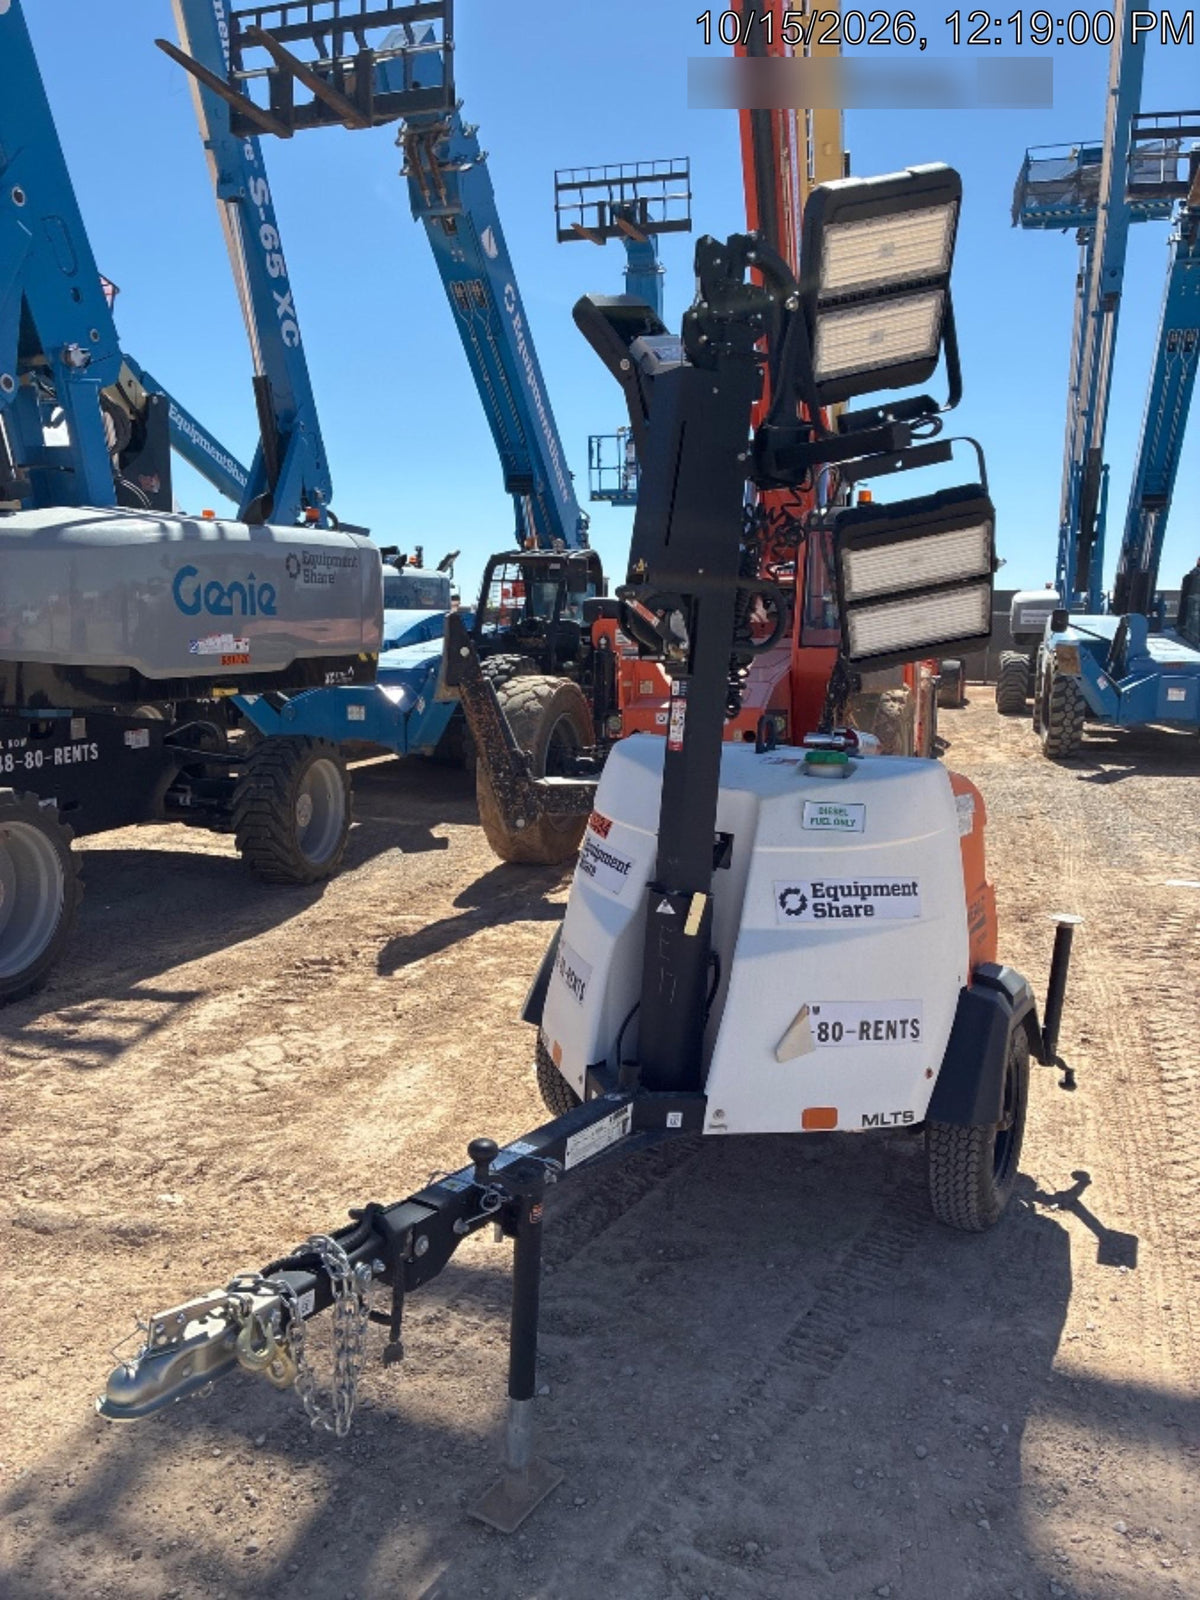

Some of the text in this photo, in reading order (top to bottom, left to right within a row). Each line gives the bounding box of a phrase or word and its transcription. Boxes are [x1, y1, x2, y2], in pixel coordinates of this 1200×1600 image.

[249, 175, 286, 279] S-65
[273, 289, 300, 348] XC
[302, 551, 359, 572] Equipment
[303, 569, 335, 584] Share
[172, 564, 277, 616] Genie
[810, 817, 856, 827] FUEL ONLY
[810, 881, 919, 902] Equipment
[812, 902, 875, 918] Share
